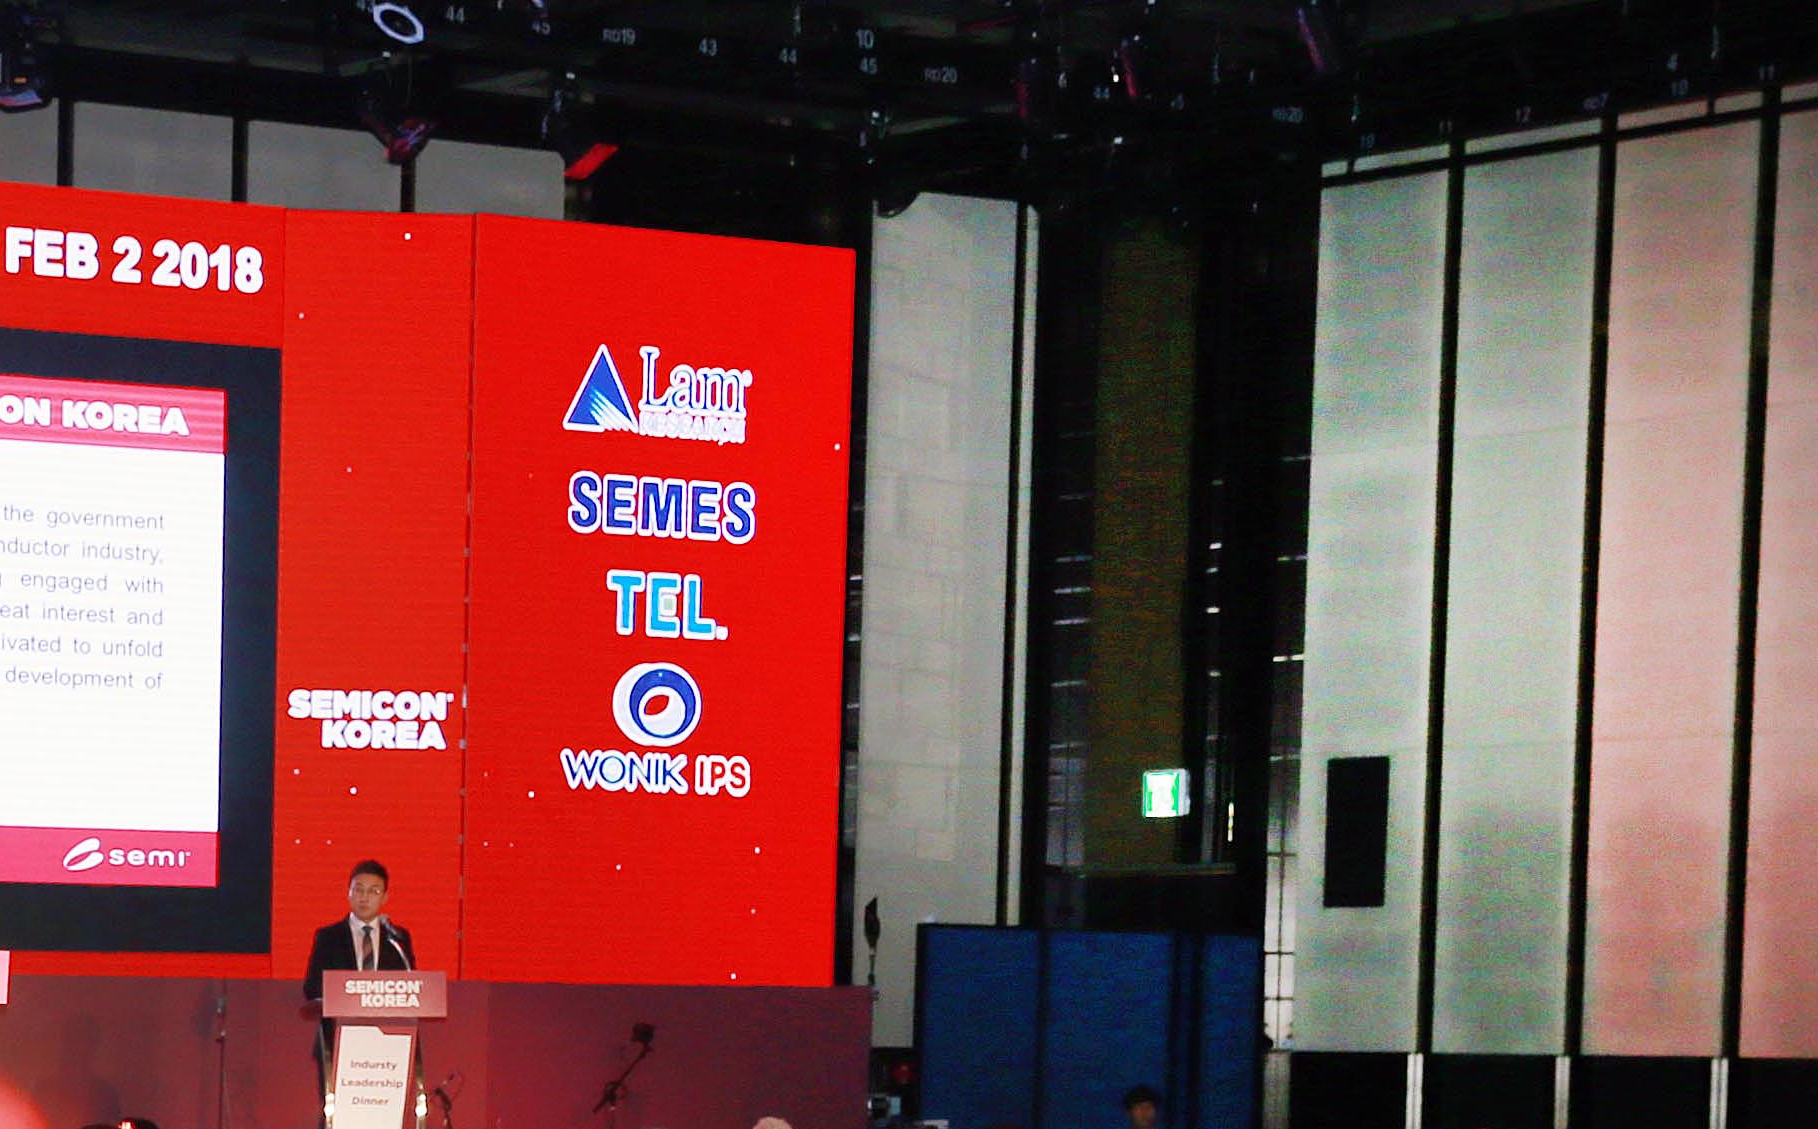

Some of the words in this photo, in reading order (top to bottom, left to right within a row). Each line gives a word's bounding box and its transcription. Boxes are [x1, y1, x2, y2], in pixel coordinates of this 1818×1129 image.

[6, 227, 98, 279] FEB
[112, 236, 141, 283] 2
[152, 240, 262, 293] 2018
[63, 400, 190, 436] KOREA
[3, 503, 35, 523] the
[46, 510, 164, 529] government
[568, 471, 755, 544] SEMES
[20, 573, 108, 595] engaged
[125, 575, 164, 593] with
[42, 604, 115, 624] interest
[126, 608, 163, 626] and
[73, 637, 91, 655] to
[102, 639, 163, 658] unfold
[5, 665, 134, 689] development
[144, 671, 164, 690] of
[322, 719, 446, 749] KOREA
[560, 749, 688, 794] WONIK
[695, 755, 750, 797] IPS
[360, 994, 421, 1008] KOREA
[342, 1079, 403, 1088] Leadership
